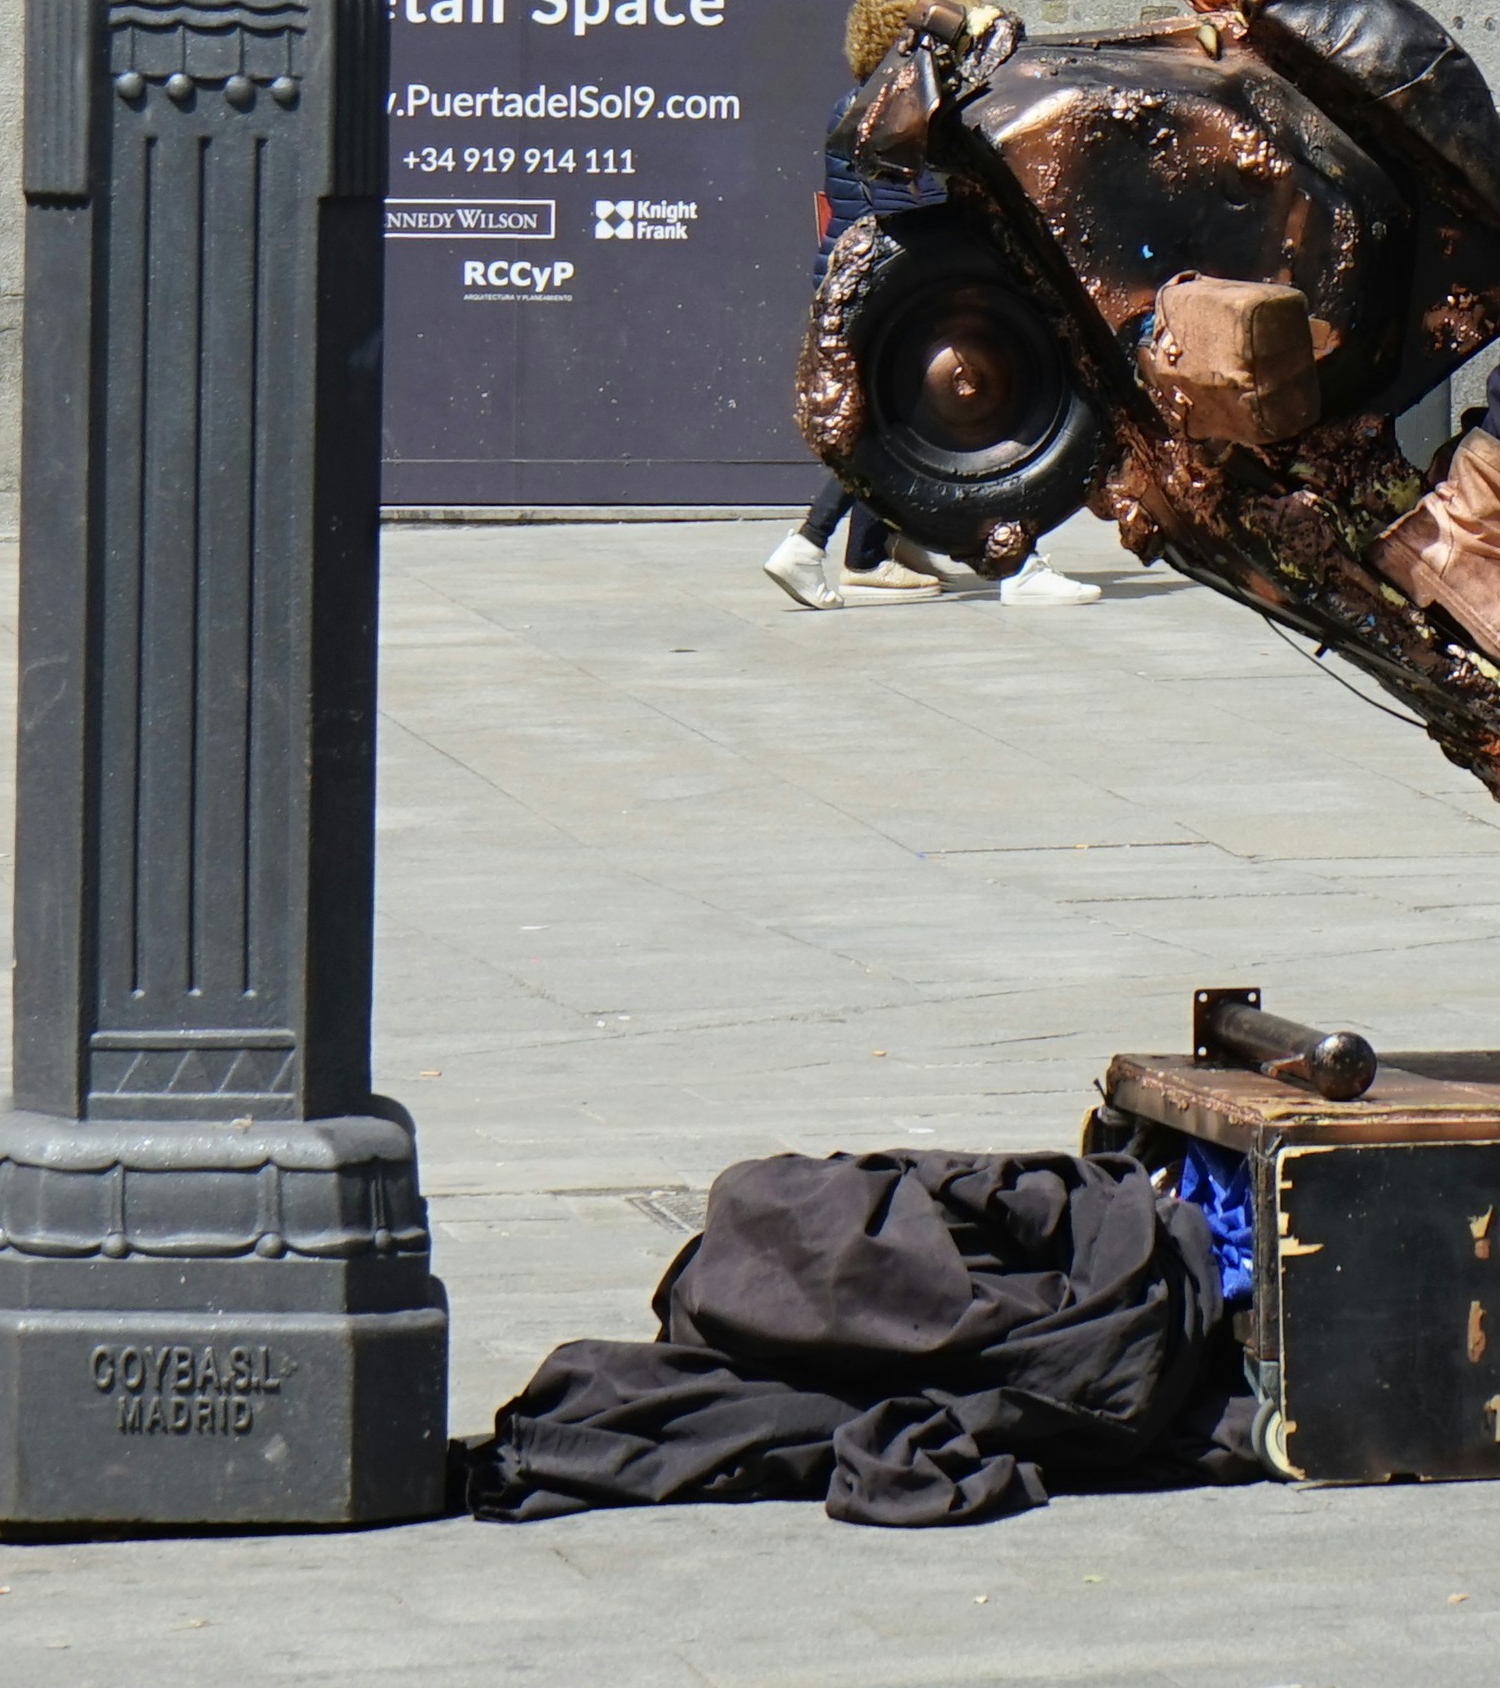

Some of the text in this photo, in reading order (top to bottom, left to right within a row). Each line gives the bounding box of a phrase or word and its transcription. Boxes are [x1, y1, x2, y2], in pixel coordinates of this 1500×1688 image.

[387, 84, 740, 120] .PuertadelSol9.com
[403, 148, 636, 174] +34 919 914 111
[384, 208, 538, 229] NNEDY WILSON
[637, 200, 699, 223] Knight
[637, 221, 688, 240] Frank
[463, 260, 576, 293] RCCyP
[117, 1395, 253, 1433] MADRID
